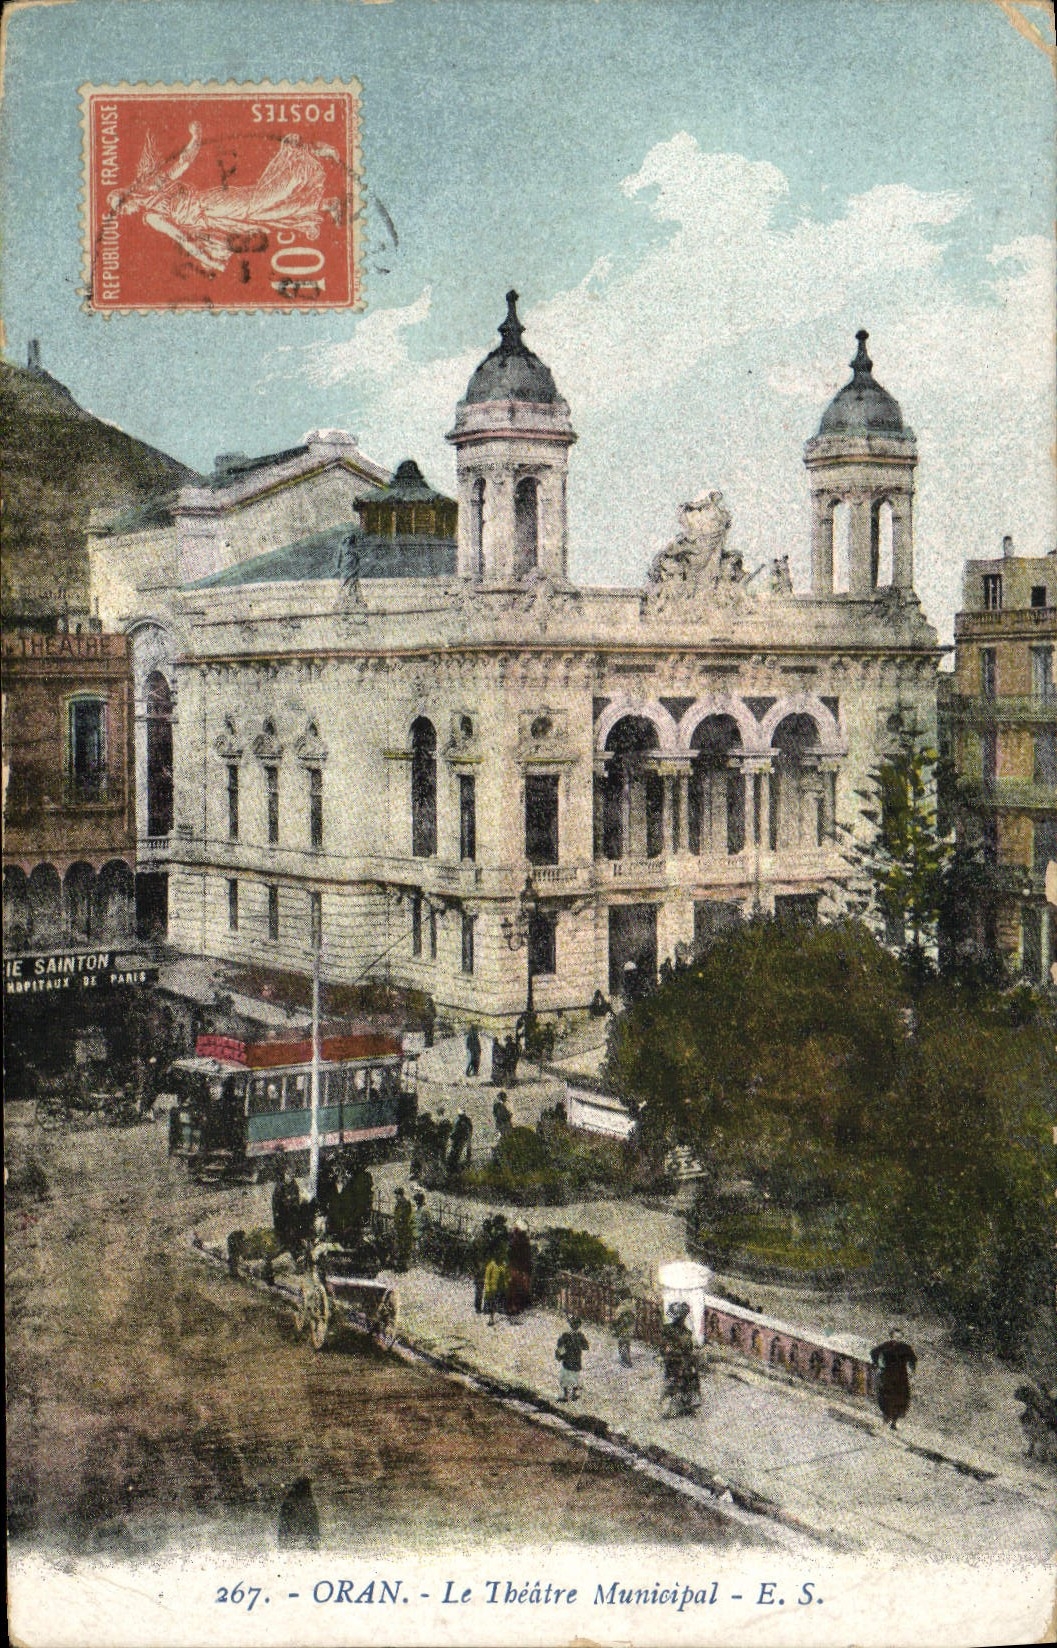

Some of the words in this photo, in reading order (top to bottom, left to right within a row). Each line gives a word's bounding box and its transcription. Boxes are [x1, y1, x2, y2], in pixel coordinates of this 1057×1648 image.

[251, 103, 335, 123] POSTES
[34, 953, 110, 975] SAINTON
[110, 971, 147, 985] PARIS
